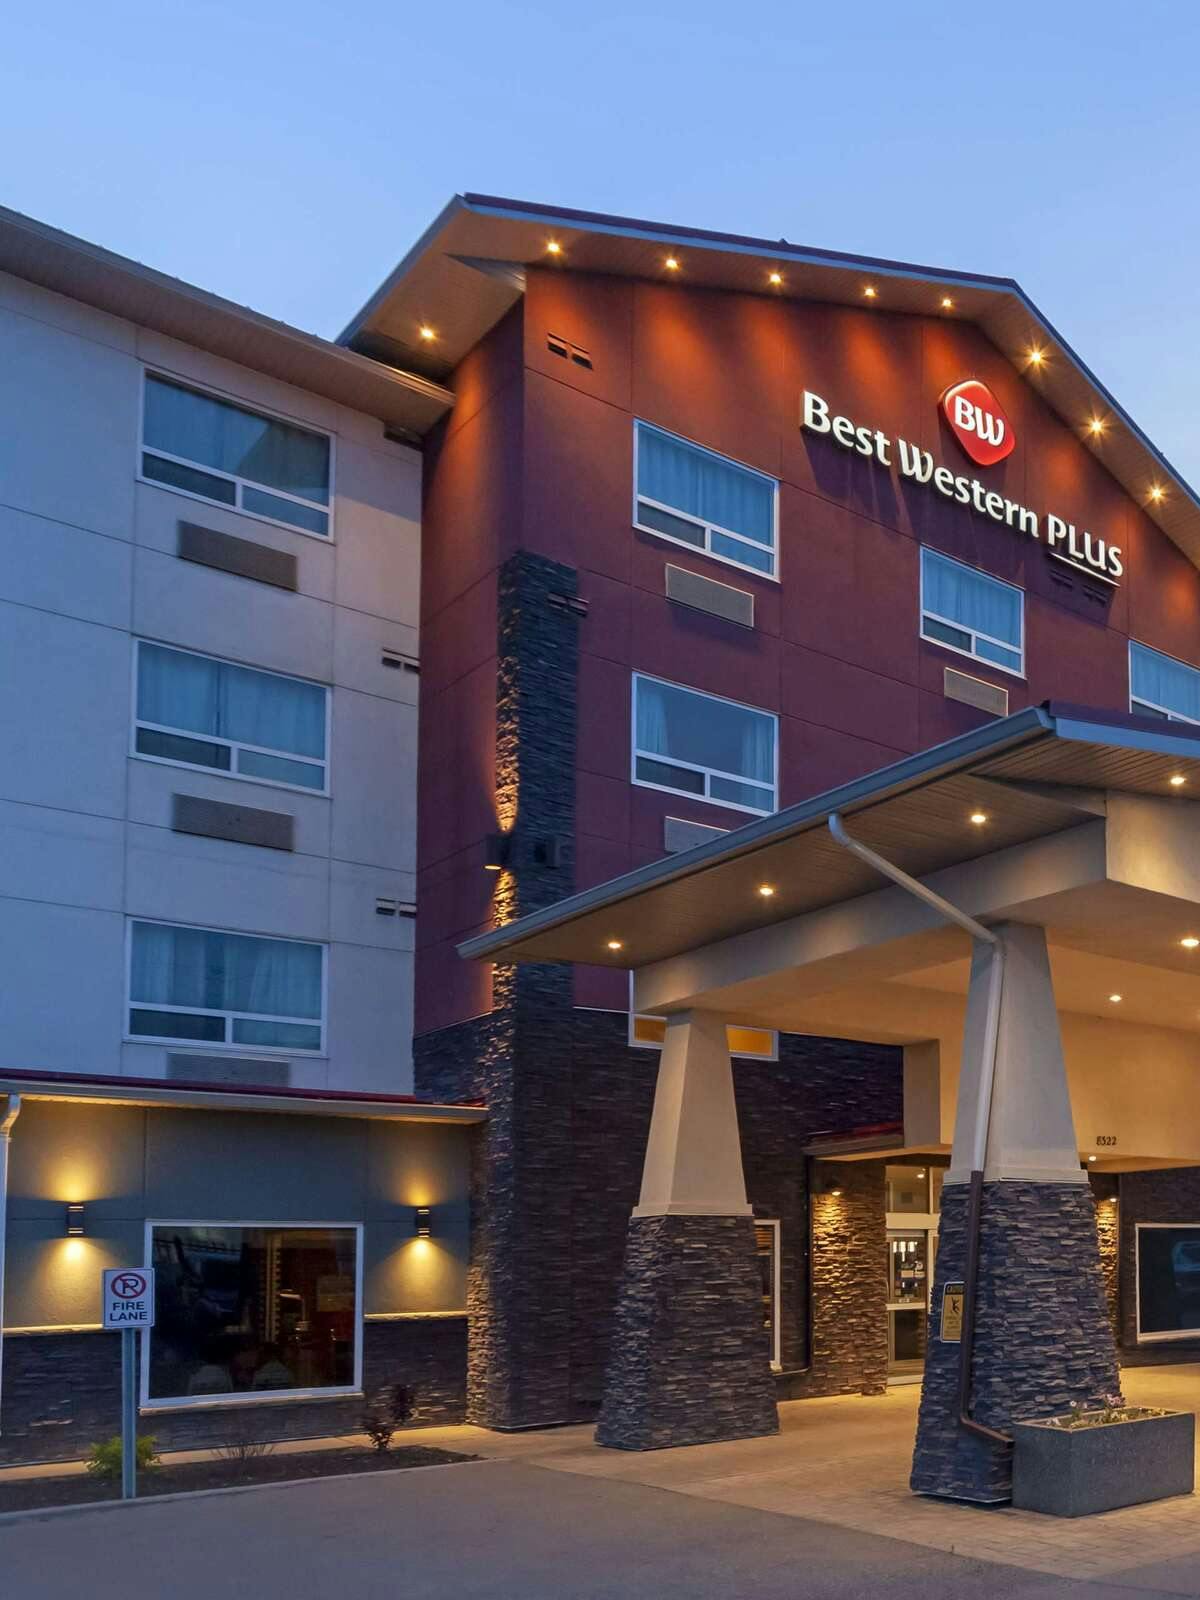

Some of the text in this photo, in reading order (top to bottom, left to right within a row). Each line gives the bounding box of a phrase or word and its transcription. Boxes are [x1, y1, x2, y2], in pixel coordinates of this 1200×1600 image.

[954, 396, 1005, 447] BW
[803, 390, 1124, 577] Best Western PLUS
[109, 1311, 148, 1322] LANE
[112, 1301, 145, 1311] FIRE
